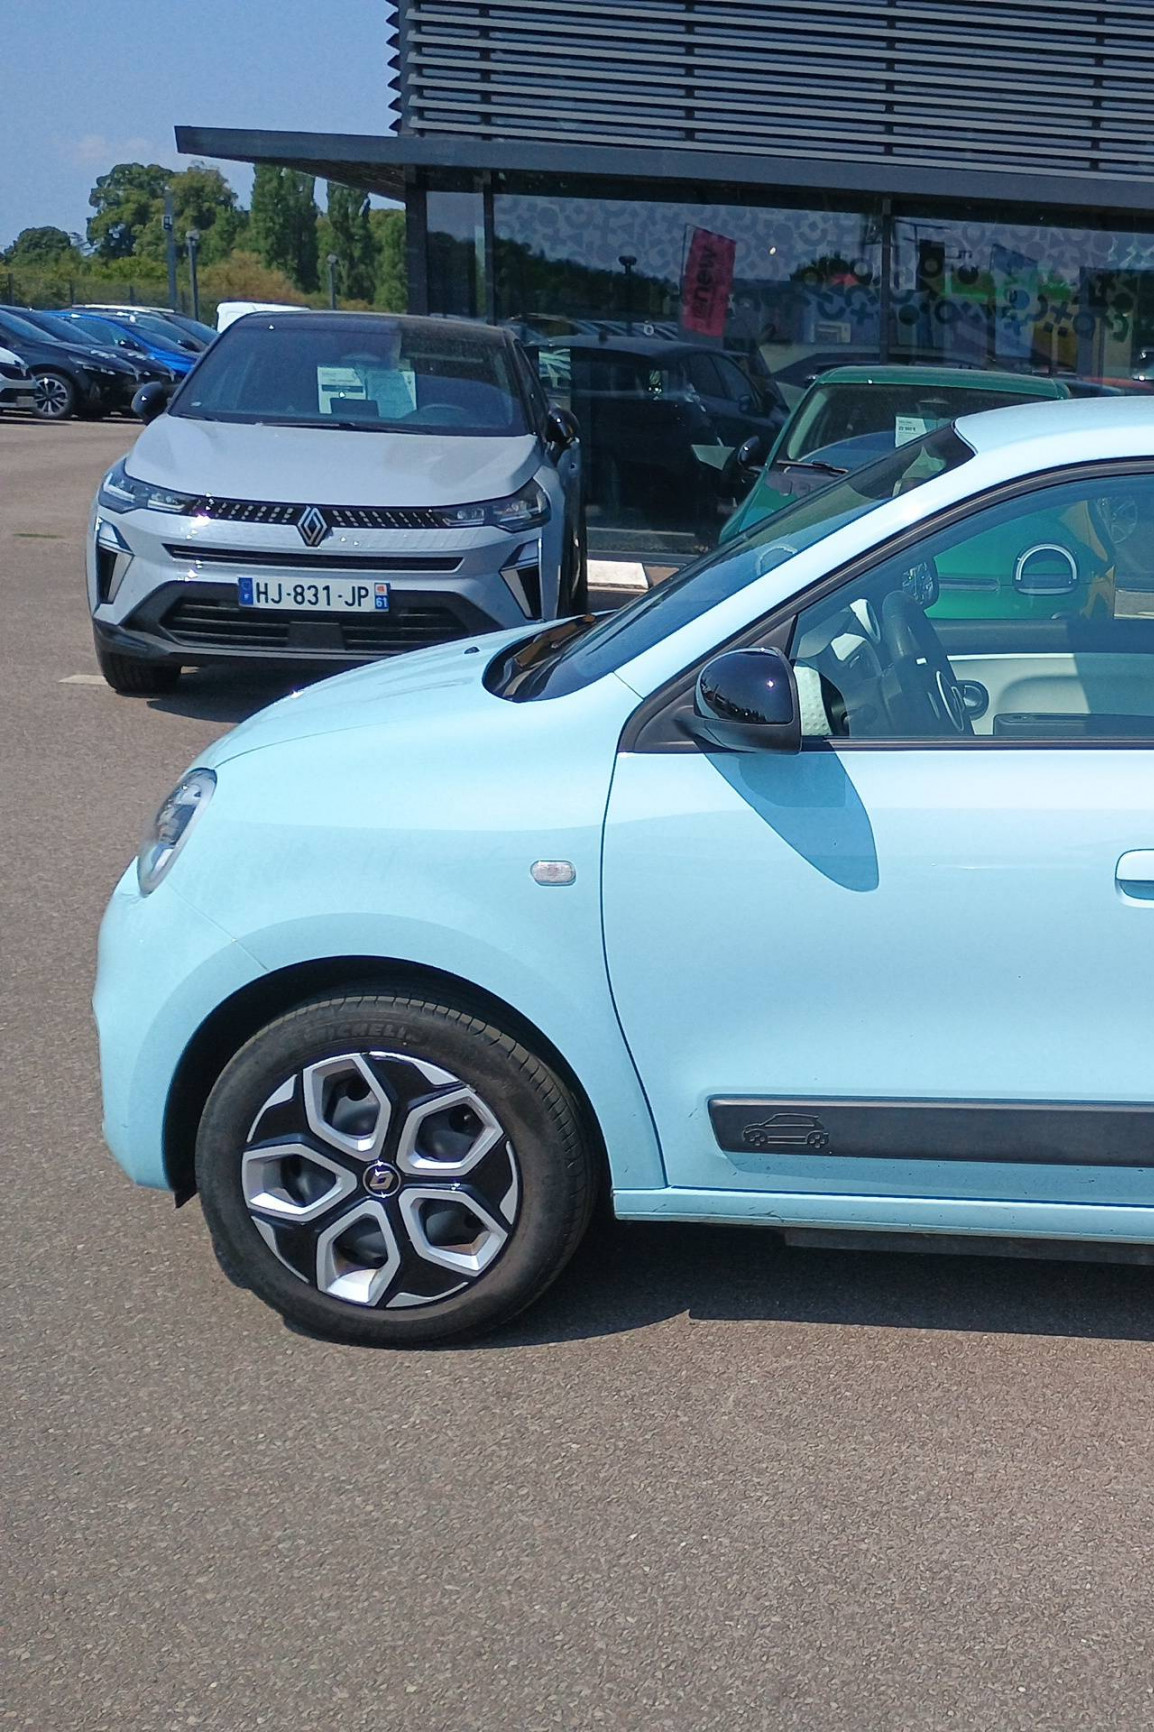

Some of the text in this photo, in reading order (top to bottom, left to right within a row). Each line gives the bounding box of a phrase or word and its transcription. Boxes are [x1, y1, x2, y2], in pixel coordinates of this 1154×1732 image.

[255, 582, 369, 607] HJ-831-JP
[375, 597, 388, 608] 61
[304, 1022, 424, 1042] ICHELI
